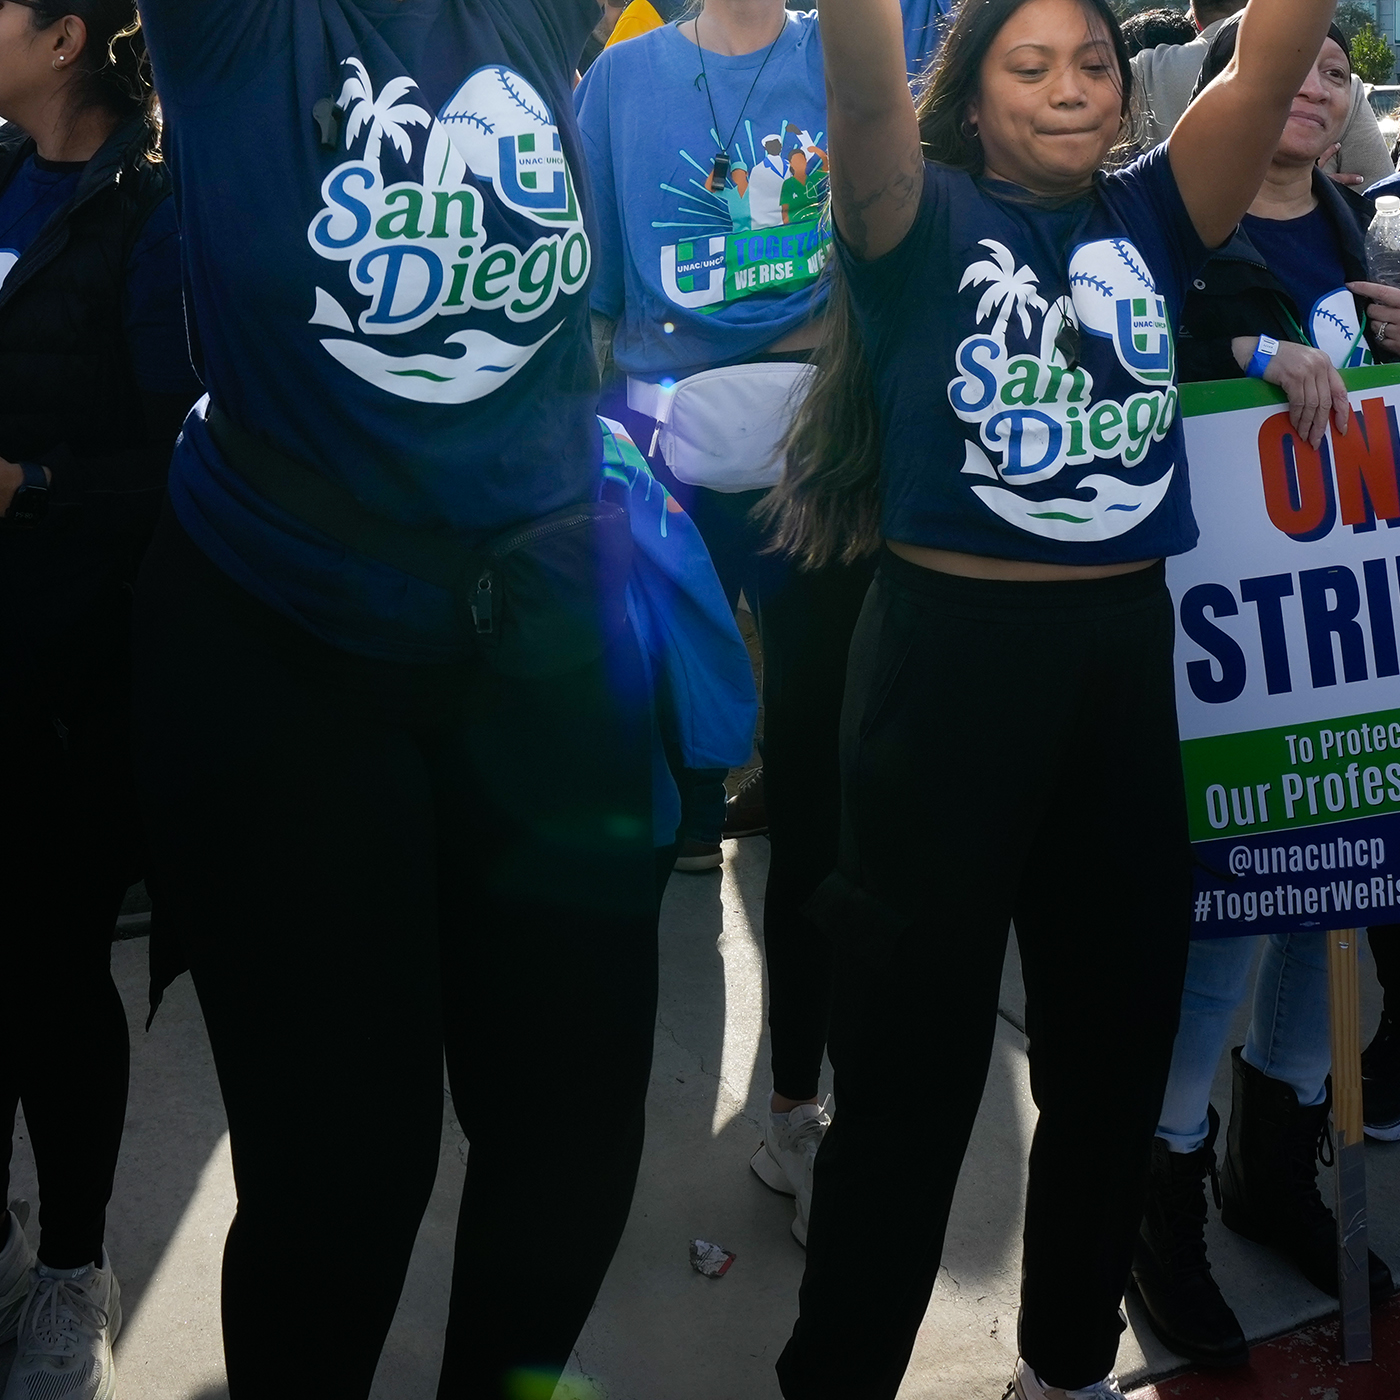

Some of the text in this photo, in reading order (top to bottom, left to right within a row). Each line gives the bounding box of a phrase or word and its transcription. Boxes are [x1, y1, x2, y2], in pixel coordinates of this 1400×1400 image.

[313, 166, 479, 250] San
[677, 256, 725, 273] UNAC/UHCP
[733, 222, 832, 267] TOGETH
[355, 232, 589, 325] Diego
[734, 267, 756, 291] WE
[759, 260, 794, 285] RISE
[950, 338, 1088, 413] San
[985, 387, 1178, 476] Diego
[1285, 733, 1315, 766] To
[1205, 775, 1273, 831] Our
[1228, 834, 1386, 877] @unacuhcp
